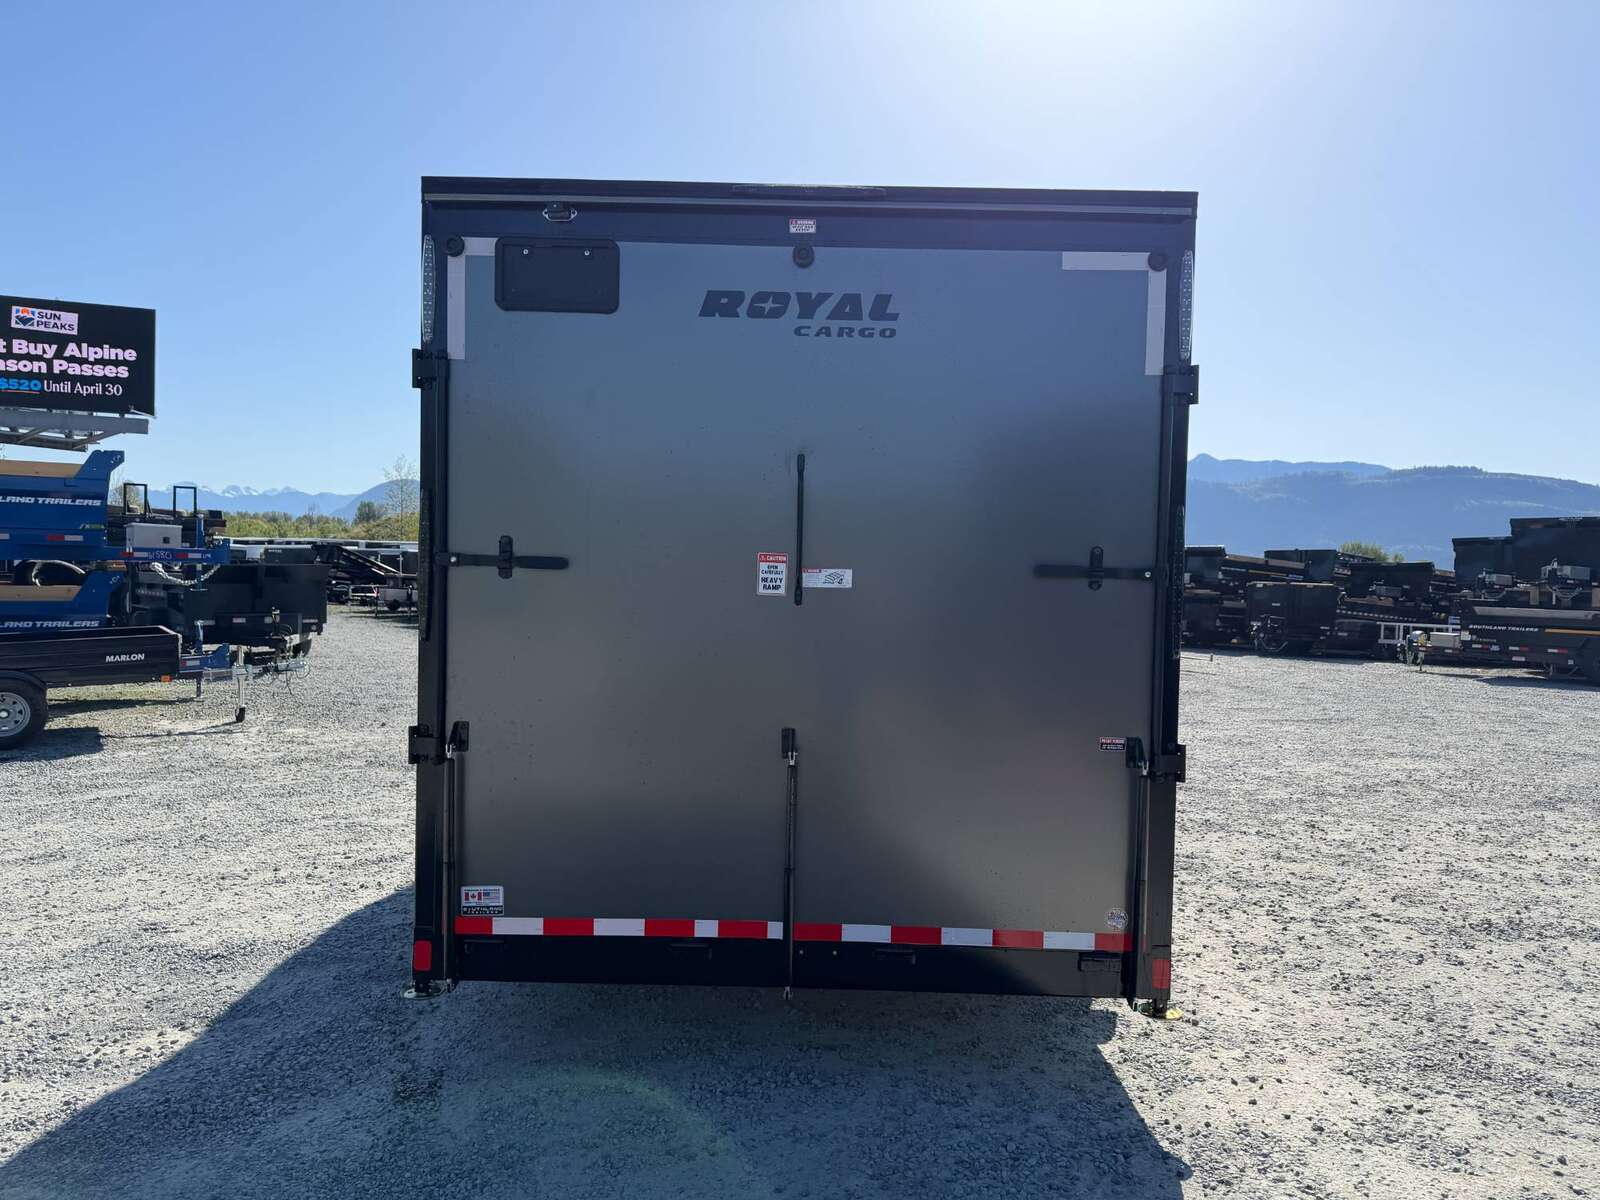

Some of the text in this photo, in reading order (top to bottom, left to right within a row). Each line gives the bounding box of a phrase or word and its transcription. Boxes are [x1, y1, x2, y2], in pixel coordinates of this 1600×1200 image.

[698, 290, 900, 321] ROYAL
[37, 311, 62, 321] SUN
[36, 320, 75, 331] PEAKS
[793, 325, 897, 338] CARGO
[12, 339, 57, 358] Buy
[63, 342, 137, 361] Alpine
[53, 359, 129, 378] Passes
[0, 377, 123, 397] $520 Until April 30
[36, 497, 102, 506] TRAILERS
[34, 620, 100, 628] TRAILERS
[105, 653, 145, 663] MARLON
